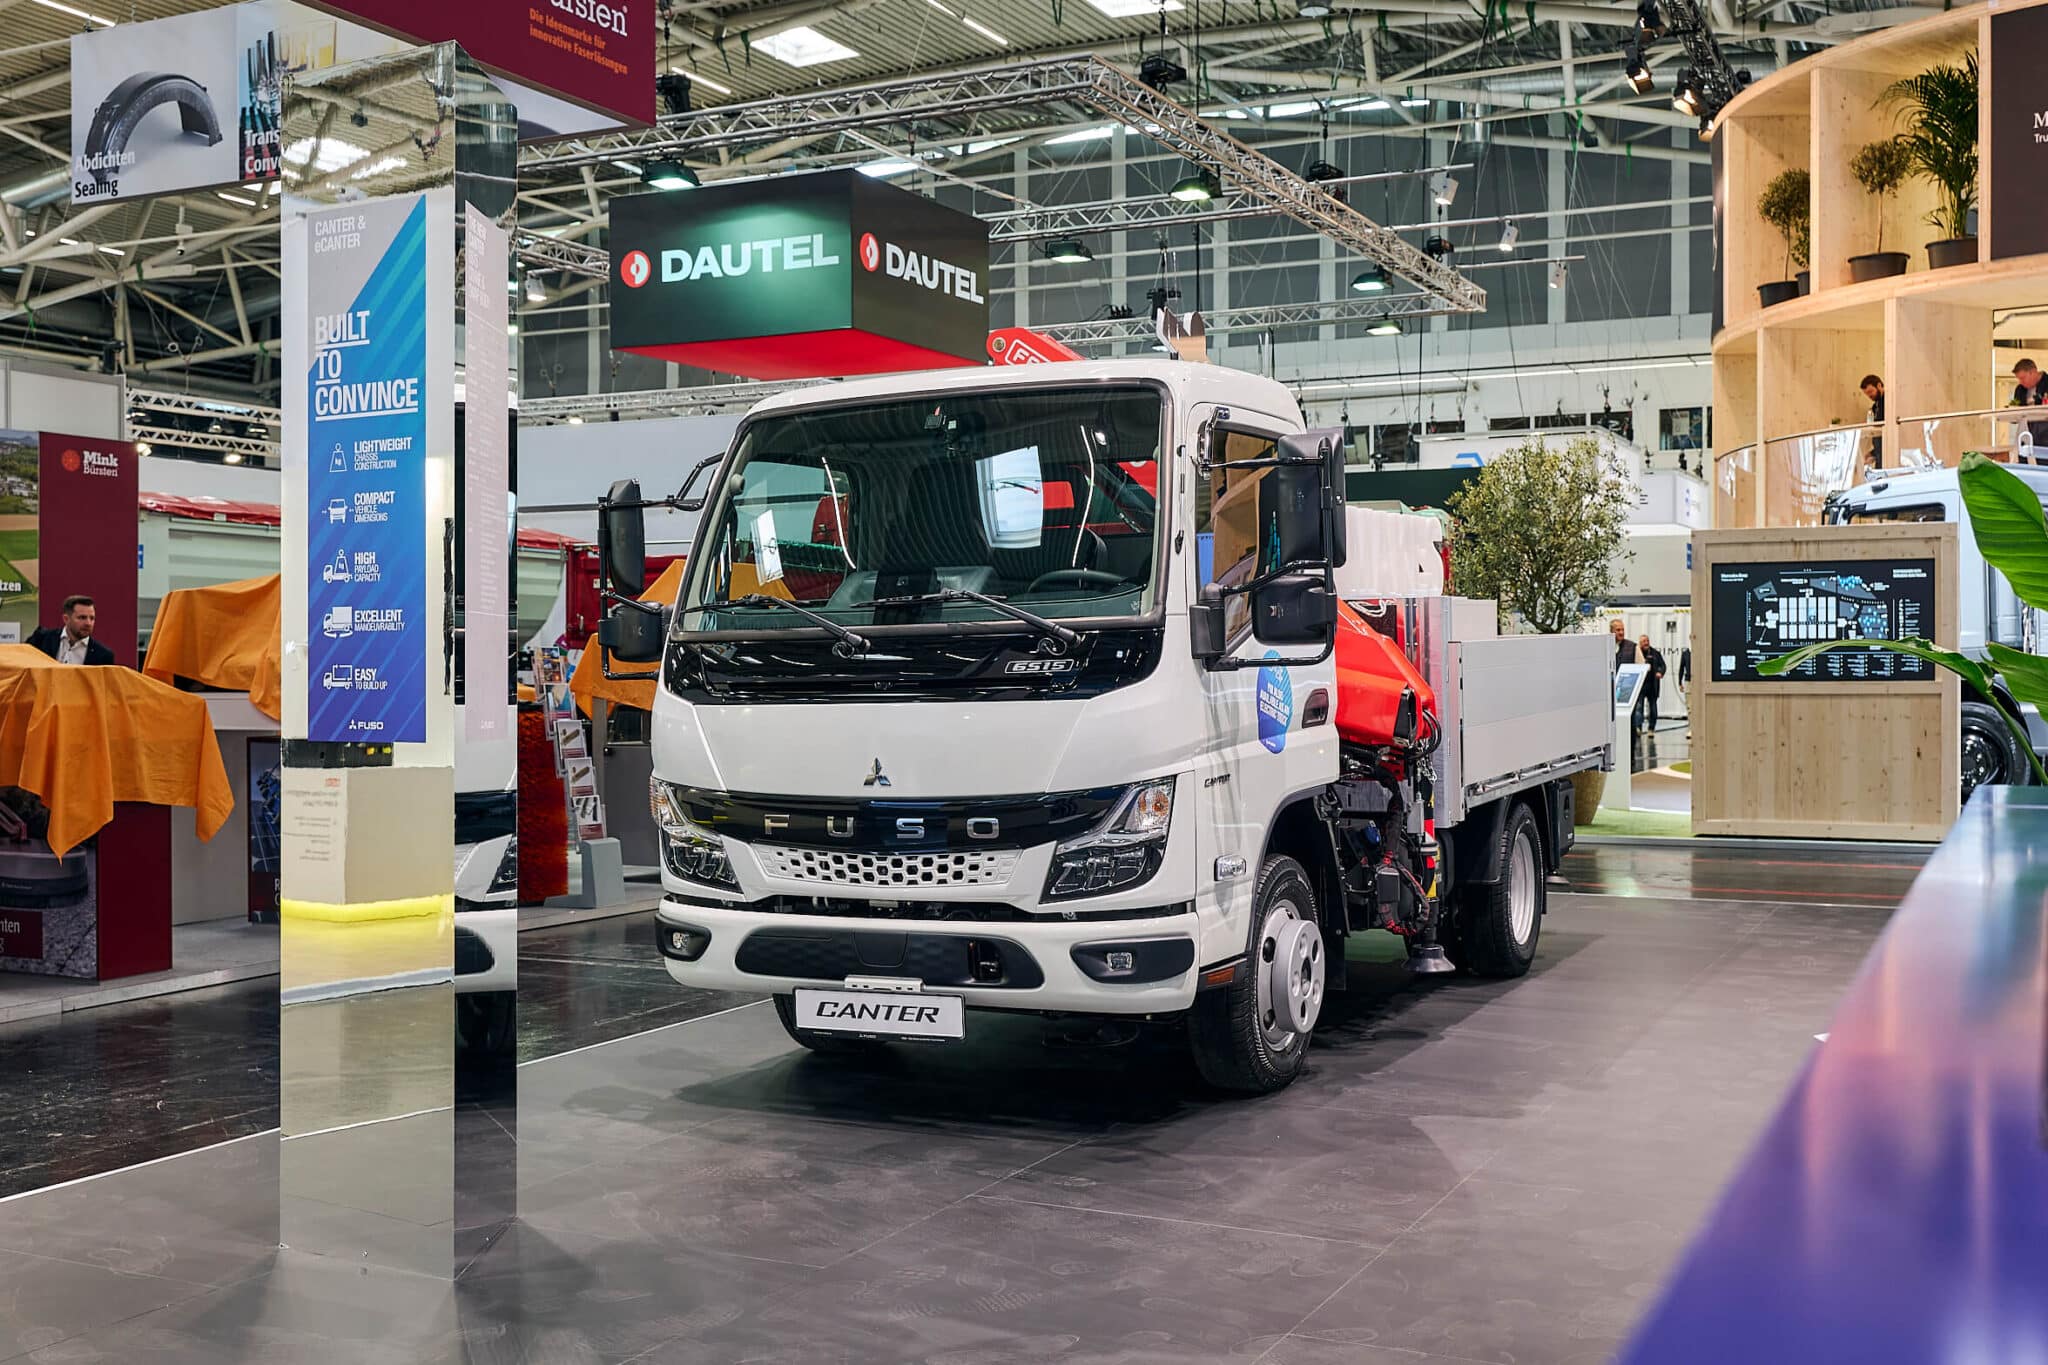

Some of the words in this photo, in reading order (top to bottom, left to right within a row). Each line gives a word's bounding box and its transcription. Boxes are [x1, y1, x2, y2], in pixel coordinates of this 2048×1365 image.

[75, 150, 136, 171] Abdichten
[75, 178, 119, 198] Sealing
[315, 216, 356, 237] CANTER
[357, 214, 367, 231] &
[315, 232, 361, 253] eCANTER
[661, 232, 839, 283] DAUTEL
[885, 242, 984, 305] DAUTEL
[315, 309, 371, 345] BUILT
[315, 349, 342, 379] TO
[315, 377, 419, 416] CONVINCE
[354, 437, 413, 453] LIGHTWEIGHT
[83, 450, 119, 466] Mink
[354, 460, 397, 472] CONSTRUCTION
[83, 463, 118, 477] Bürsten
[354, 491, 396, 506] COMPACT
[354, 551, 376, 565] HIGH
[354, 609, 404, 623] EXCELLENT
[354, 668, 378, 681] EASY
[358, 721, 384, 730] FUSO
[764, 814, 1000, 839] FUSO
[816, 1001, 940, 1023] CANTER
